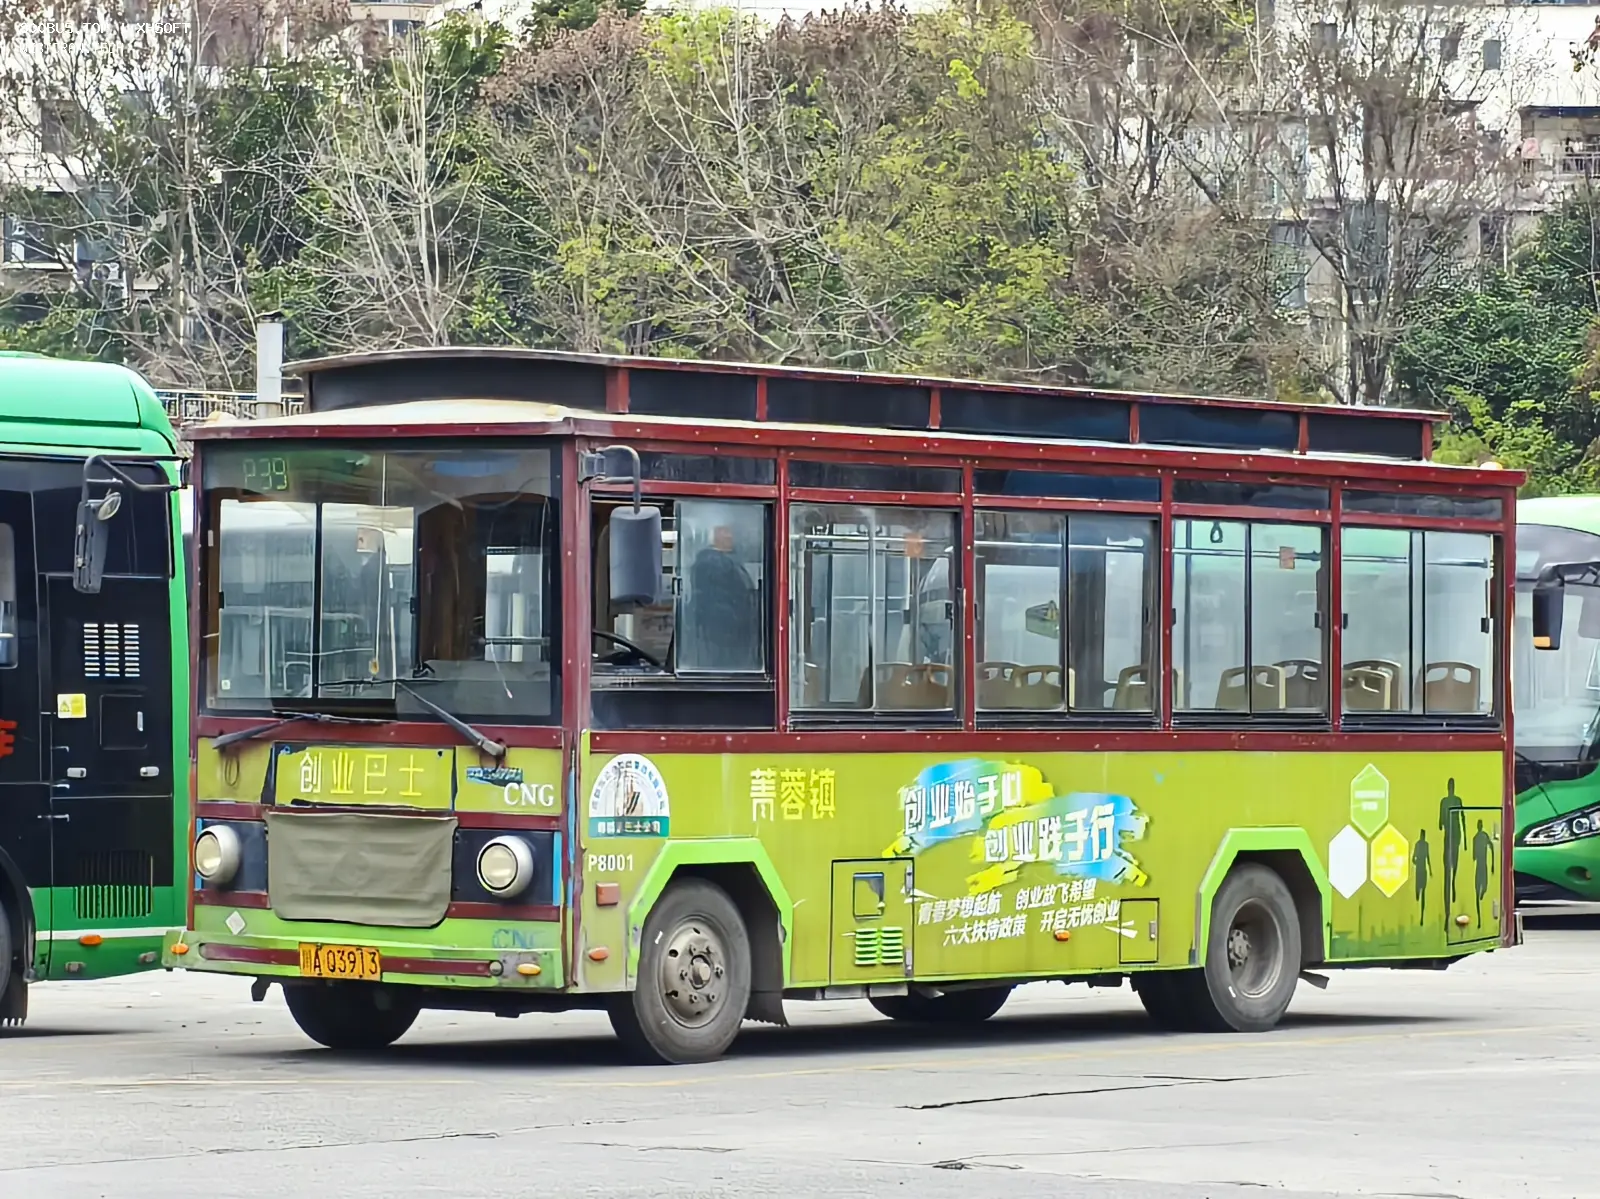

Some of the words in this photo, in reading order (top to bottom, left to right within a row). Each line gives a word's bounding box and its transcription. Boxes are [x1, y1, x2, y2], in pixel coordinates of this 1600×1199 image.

[299, 750, 426, 797] 创业巴士
[503, 782, 555, 807] CNG
[750, 768, 836, 822] 菁蓉镇
[984, 802, 1115, 864] 创业践于行
[587, 854, 634, 873] P8001
[917, 890, 1003, 926] 青春梦想起航
[1015, 877, 1098, 911] 创业放飞希望
[942, 913, 1029, 947] 六大扶持政策
[1039, 898, 1121, 933] 开启无忧创业
